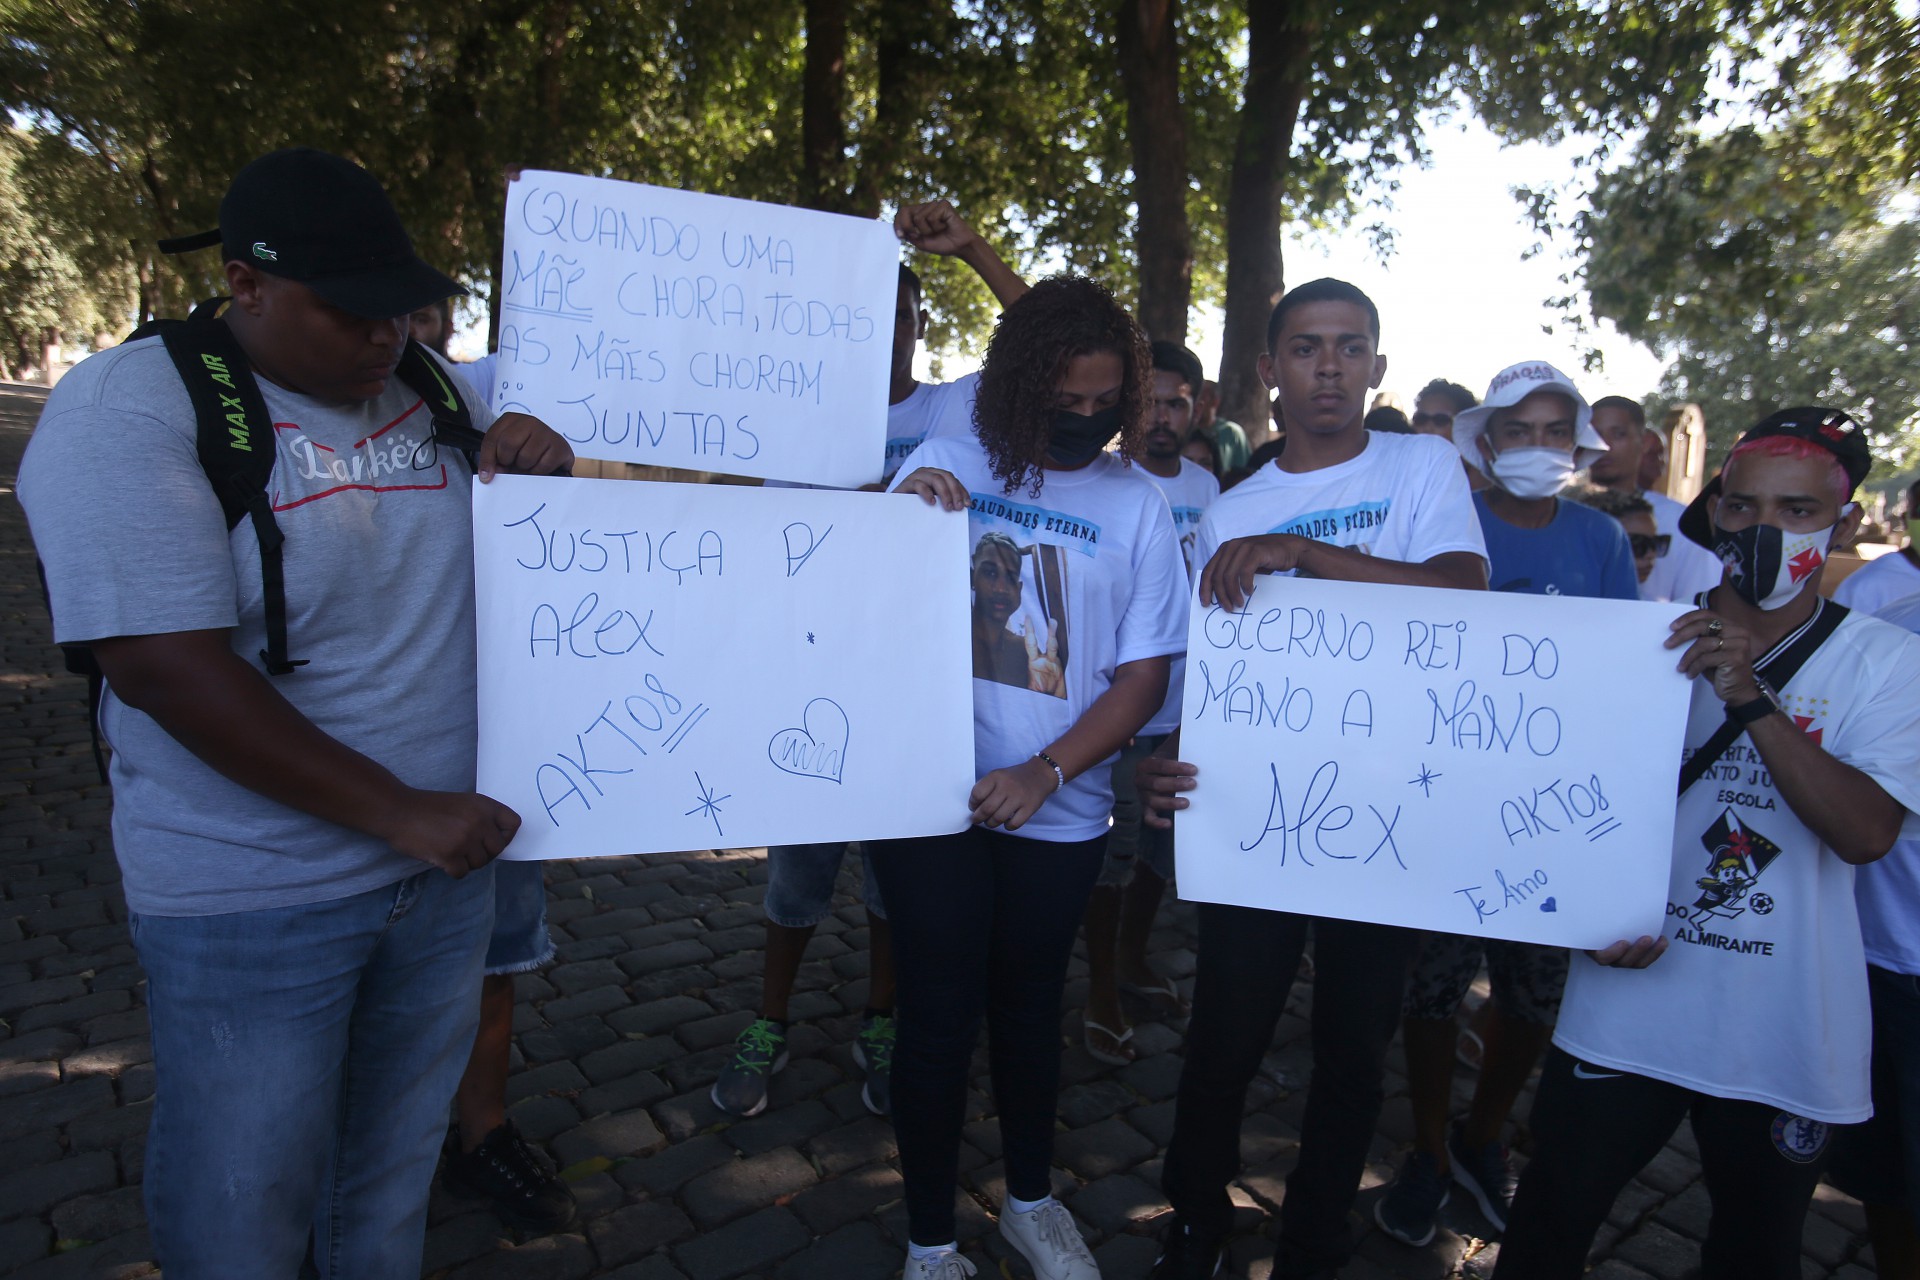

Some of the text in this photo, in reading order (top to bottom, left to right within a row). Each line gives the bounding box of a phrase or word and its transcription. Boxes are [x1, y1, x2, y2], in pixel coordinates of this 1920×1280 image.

[523, 187, 794, 276] QUANDO UMA
[500, 325, 823, 405] AS MÃES CHORAM
[200, 353, 253, 452] MAX AIR
[557, 393, 760, 461] JUNTAS
[503, 503, 723, 586] JUSTIÇA
[970, 498, 1098, 544] SAUDADES ETERNA
[1502, 634, 1559, 680] DO
[1195, 659, 1313, 732] MANO
[1342, 689, 1373, 737] A
[1717, 789, 1776, 812] ESCOLA
[1453, 886, 1499, 925] Te
[1675, 927, 1774, 956] ALMIRANTE
